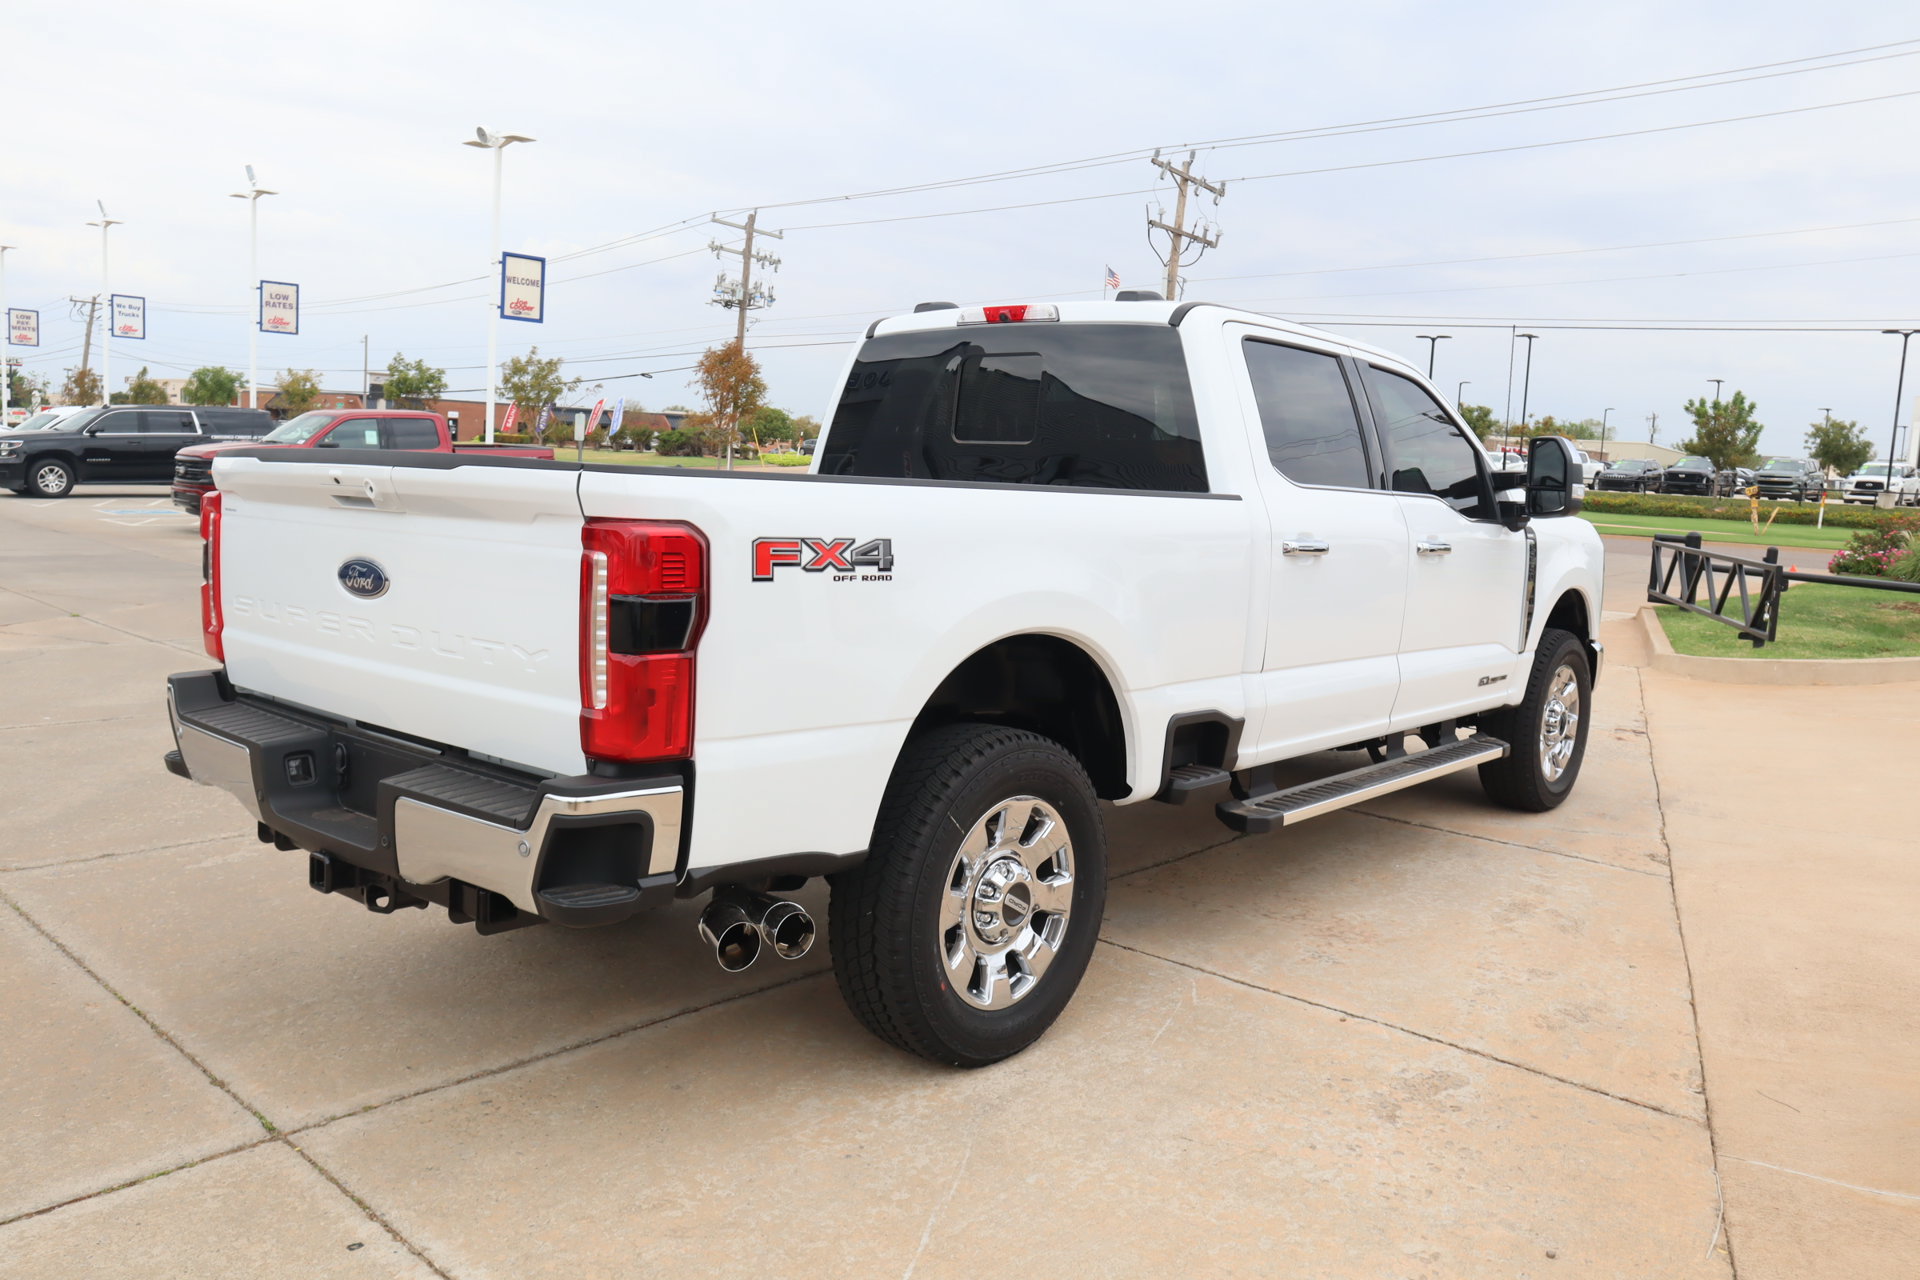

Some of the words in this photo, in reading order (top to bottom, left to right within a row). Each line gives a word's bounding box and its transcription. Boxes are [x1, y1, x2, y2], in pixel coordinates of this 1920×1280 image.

[506, 276, 540, 288] WELCOME
[270, 293, 289, 301] LOW
[516, 297, 529, 306] Joe
[265, 300, 294, 310] RATES
[509, 301, 535, 312] Cooper
[118, 310, 140, 318] Trucks
[752, 536, 894, 582] FX4
[345, 564, 375, 591] Ford
[862, 574, 893, 582] ROAD
[232, 594, 376, 642] SUPER
[391, 623, 549, 673] DUTY
[1008, 898, 1026, 911] FORD
